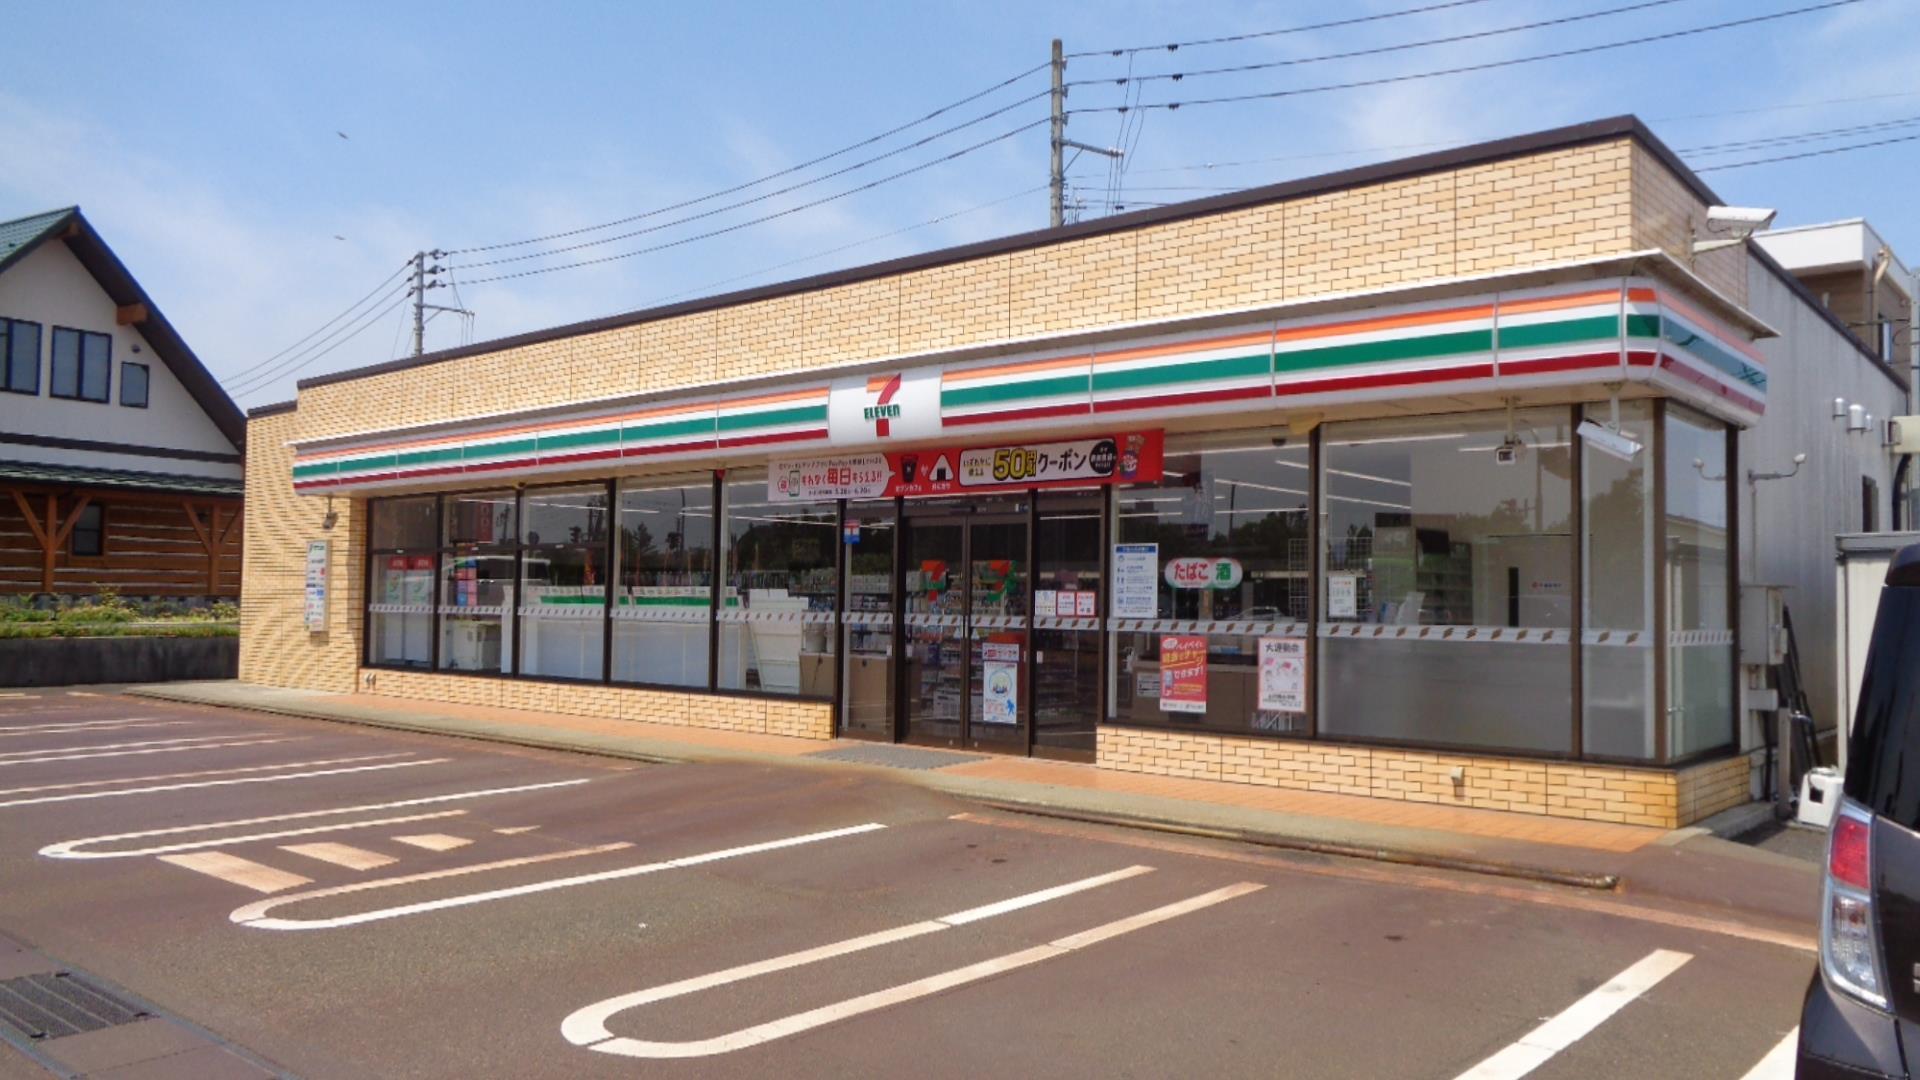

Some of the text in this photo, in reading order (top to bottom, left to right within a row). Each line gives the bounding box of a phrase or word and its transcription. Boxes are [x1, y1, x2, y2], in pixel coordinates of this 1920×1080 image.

[1173, 561, 1233, 581] たばこ 酒
